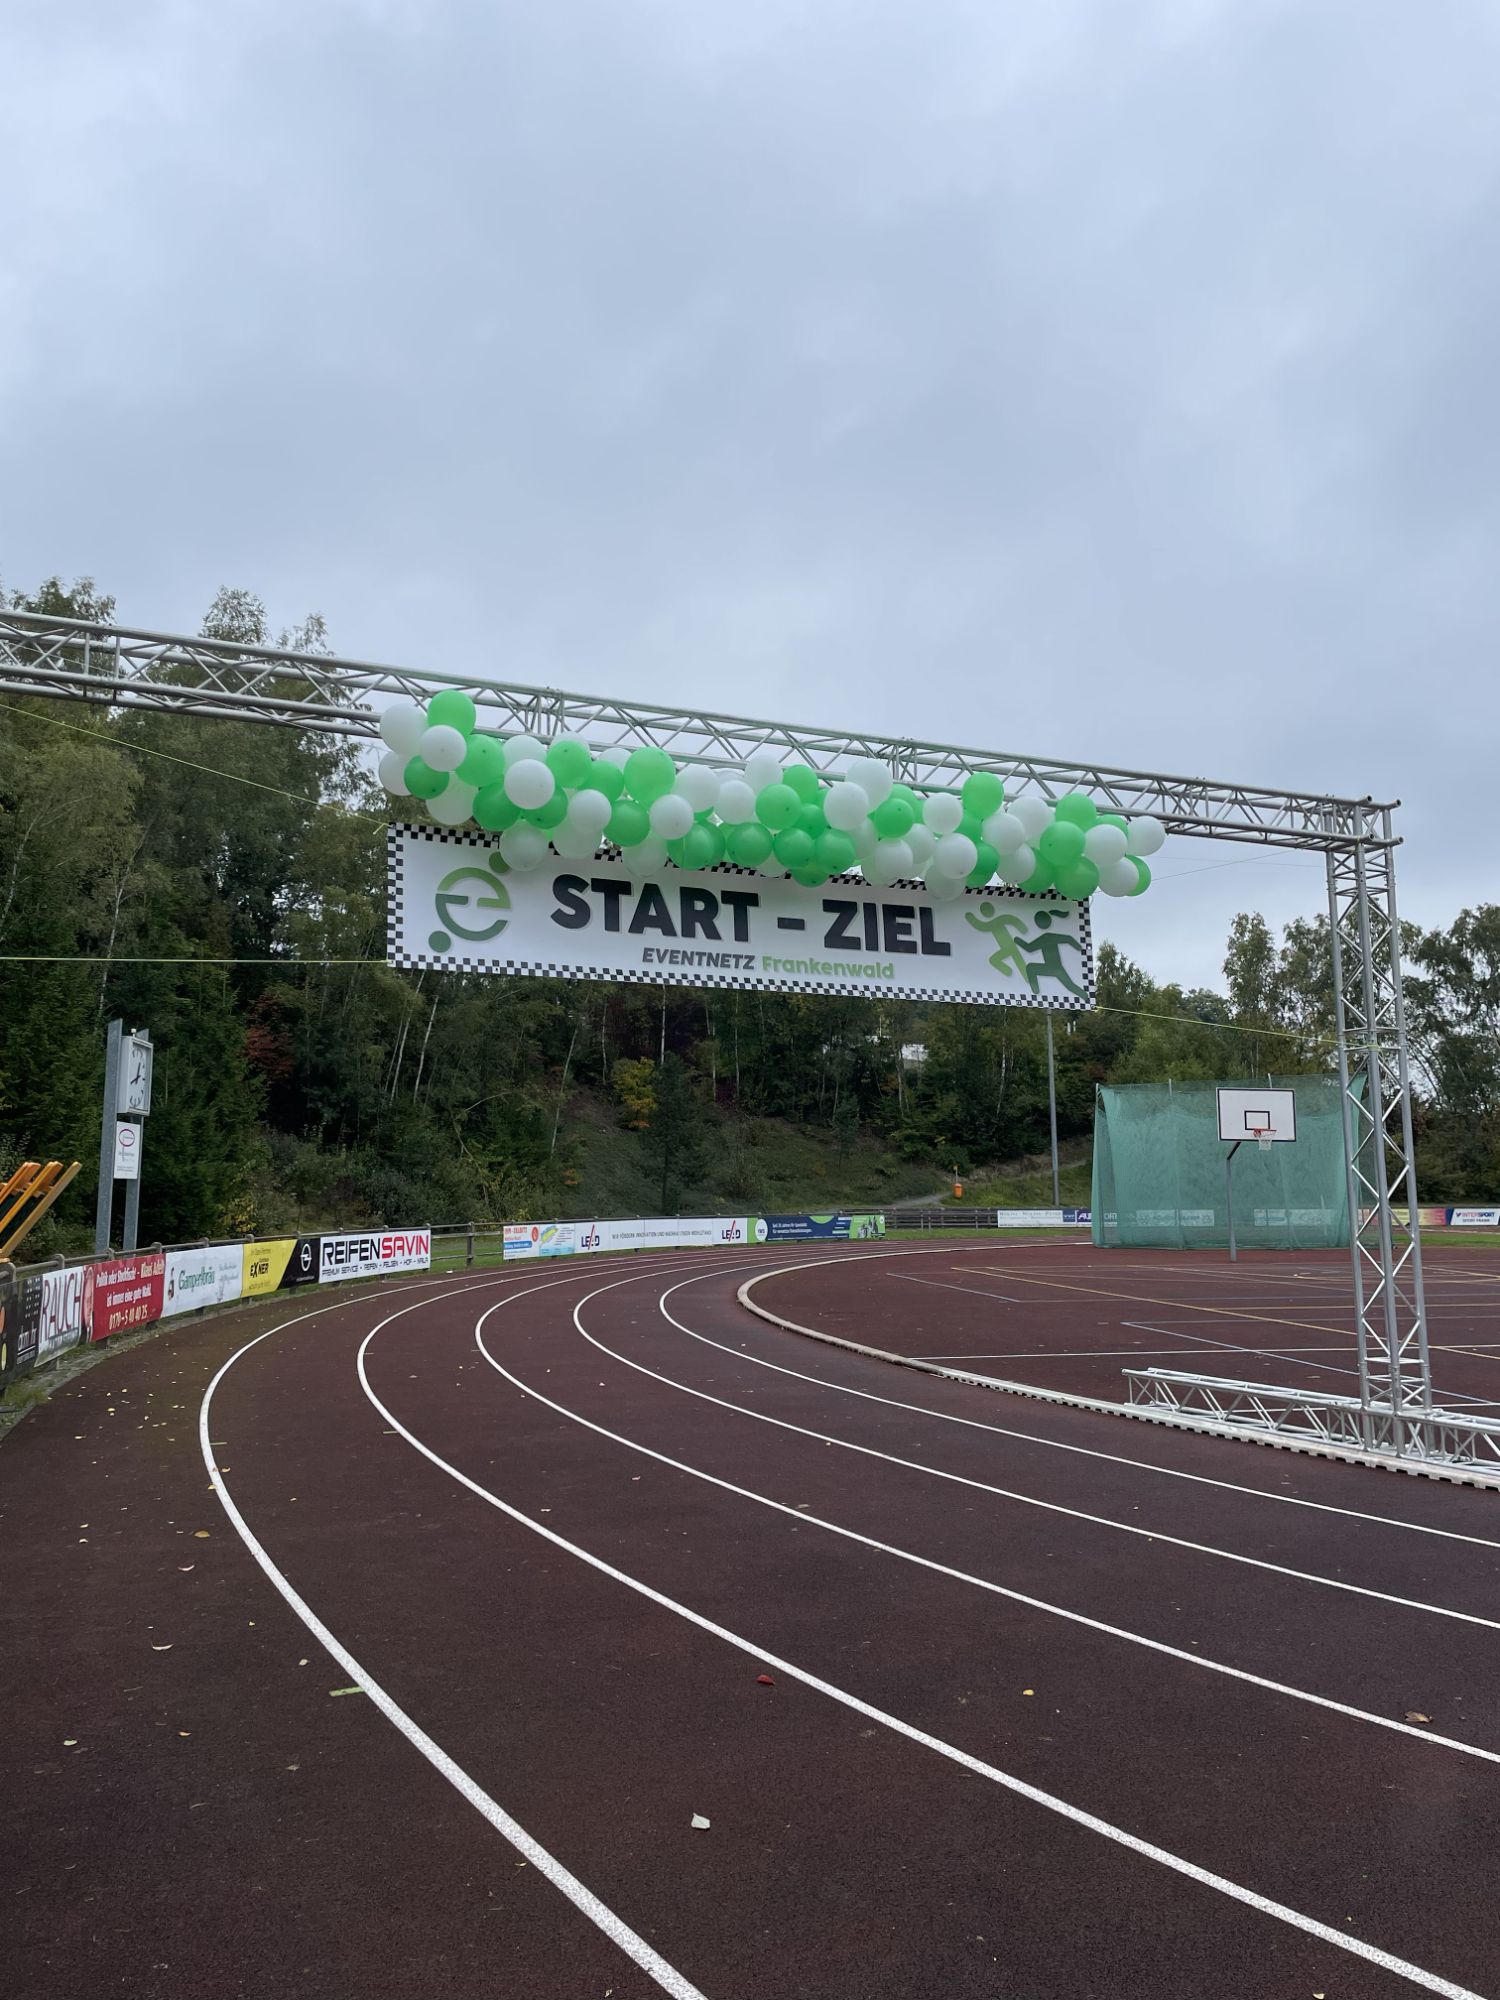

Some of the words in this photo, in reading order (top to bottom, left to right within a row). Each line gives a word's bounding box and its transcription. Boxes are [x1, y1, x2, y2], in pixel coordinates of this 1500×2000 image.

[550, 873, 760, 942] START
[777, 916, 805, 931] -
[822, 898, 952, 956] ZIEL
[642, 946, 756, 970] EVENTNETZ
[762, 955, 895, 979] Frankenwald
[40, 1272, 84, 1343] RAUCH
[112, 1290, 125, 1306] immer
[124, 1288, 133, 1303] eine
[133, 1287, 142, 1304] gute
